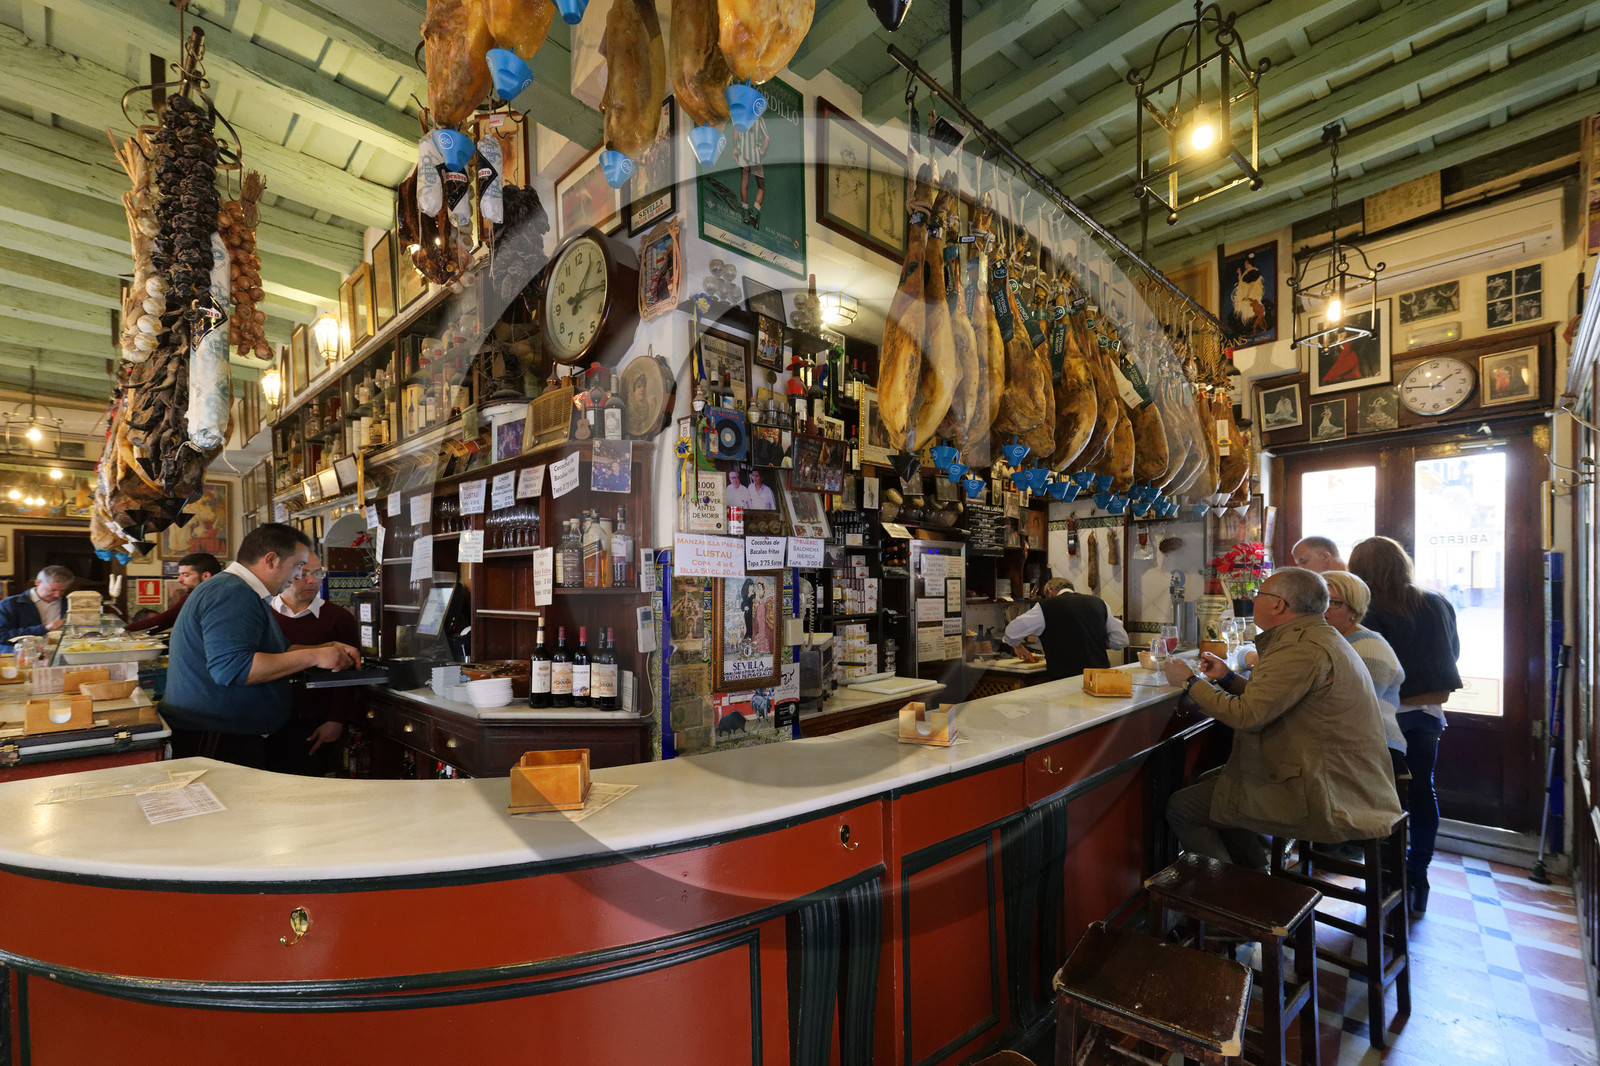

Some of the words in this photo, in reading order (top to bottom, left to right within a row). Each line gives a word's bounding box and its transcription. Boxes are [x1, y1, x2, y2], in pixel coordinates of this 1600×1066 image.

[638, 198, 664, 218] SEVILLA
[575, 252, 583, 267] 12
[566, 265, 571, 278] 11
[596, 260, 602, 274] 2
[558, 282, 565, 295] 10
[600, 280, 606, 292] 3
[555, 304, 561, 316] 9
[598, 302, 603, 314] 4
[559, 322, 565, 334] 8
[590, 321, 596, 334] 5
[568, 332, 574, 344] 7
[579, 332, 585, 344] 6
[553, 486, 562, 494] Tapa
[677, 538, 720, 547] MANZANILLA
[722, 540, 744, 549] PASADA
[696, 548, 732, 559] LUSTAU
[732, 660, 764, 671] SEVILLA
